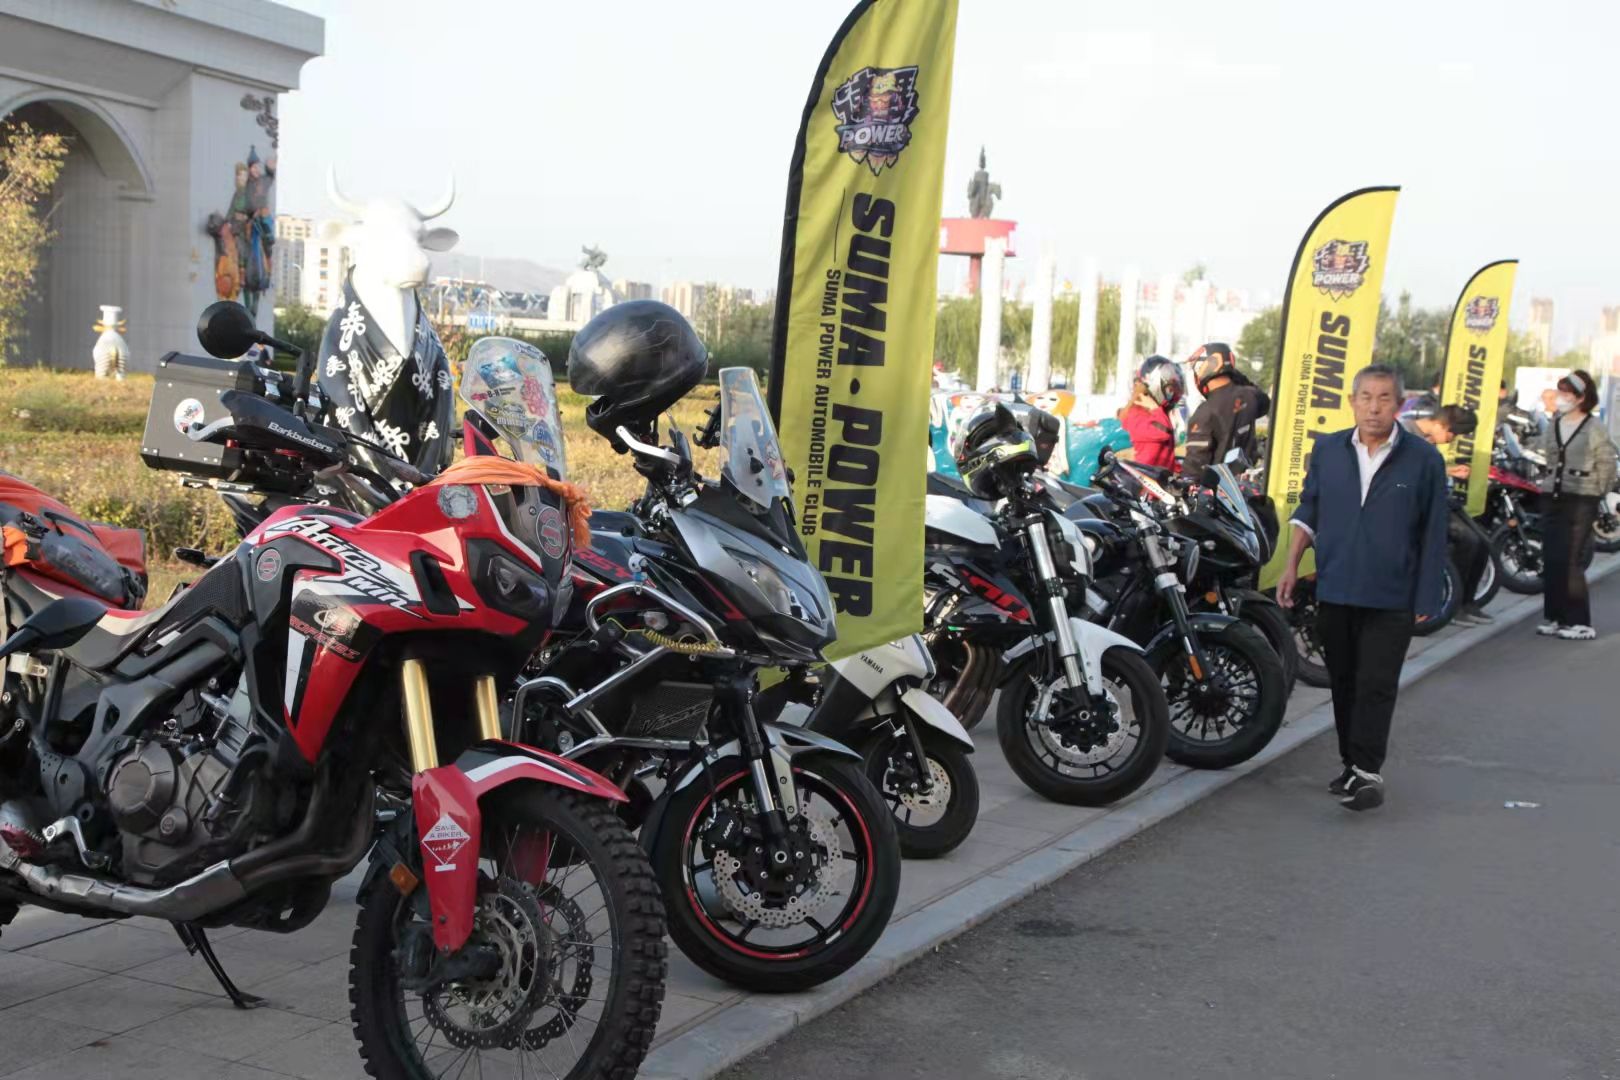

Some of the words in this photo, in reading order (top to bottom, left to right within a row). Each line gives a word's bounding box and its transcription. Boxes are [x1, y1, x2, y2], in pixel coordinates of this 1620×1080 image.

[840, 123, 904, 148] POWER
[821, 268, 842, 317] SUMA
[837, 192, 896, 366] SUMA
[1314, 273, 1360, 286] POWER
[816, 322, 836, 379] POWER
[1300, 353, 1313, 381] SUMA
[1310, 310, 1351, 410] SUMA
[1295, 383, 1309, 416] POWER
[267, 421, 334, 453] Barkbusters
[807, 384, 830, 487] AUTOMOBILE
[1288, 418, 1305, 477] AUTOMOBILE
[801, 491, 820, 537] CLUB
[819, 403, 884, 618] POWER
[1286, 479, 1299, 505] CLUB
[284, 517, 387, 573] Africa
[860, 653, 884, 675] YAMAHA
